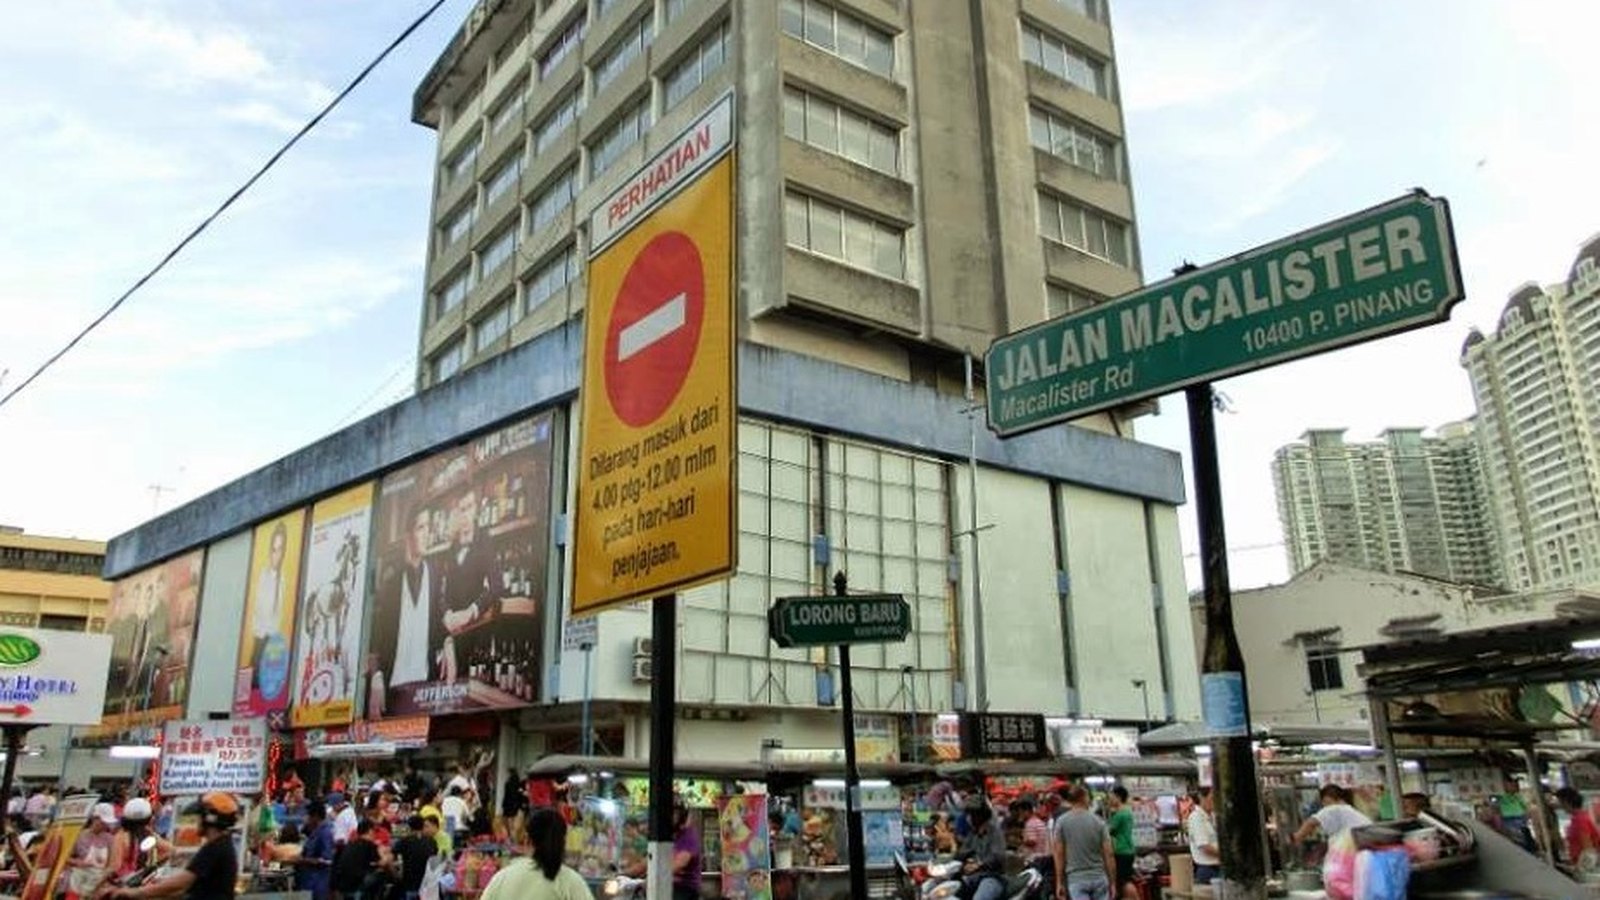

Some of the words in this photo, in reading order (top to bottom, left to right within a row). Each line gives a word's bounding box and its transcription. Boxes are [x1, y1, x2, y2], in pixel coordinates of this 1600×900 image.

[608, 124, 712, 229] PERHATIAN
[997, 317, 1108, 391] JALAN
[1121, 213, 1427, 354] MACALISTER
[1241, 316, 1304, 354] 10400
[1309, 307, 1330, 335] P.
[1335, 279, 1435, 328] PINANG
[999, 375, 1101, 424] Macalister
[1104, 360, 1135, 392] Rd
[589, 443, 640, 481] Dilarang
[643, 414, 687, 457] masuk
[690, 396, 720, 434] dari
[592, 483, 618, 513] 4.00
[621, 455, 681, 503] ptg-12.00
[684, 443, 717, 476] mlm
[603, 512, 634, 548] pada
[636, 487, 696, 532] hari-hari
[611, 540, 681, 581] penjajaan.
[790, 603, 857, 626] LORONG
[860, 602, 901, 623] BARU
[17, 674, 78, 694] HOTEL
[168, 757, 205, 767] Famous
